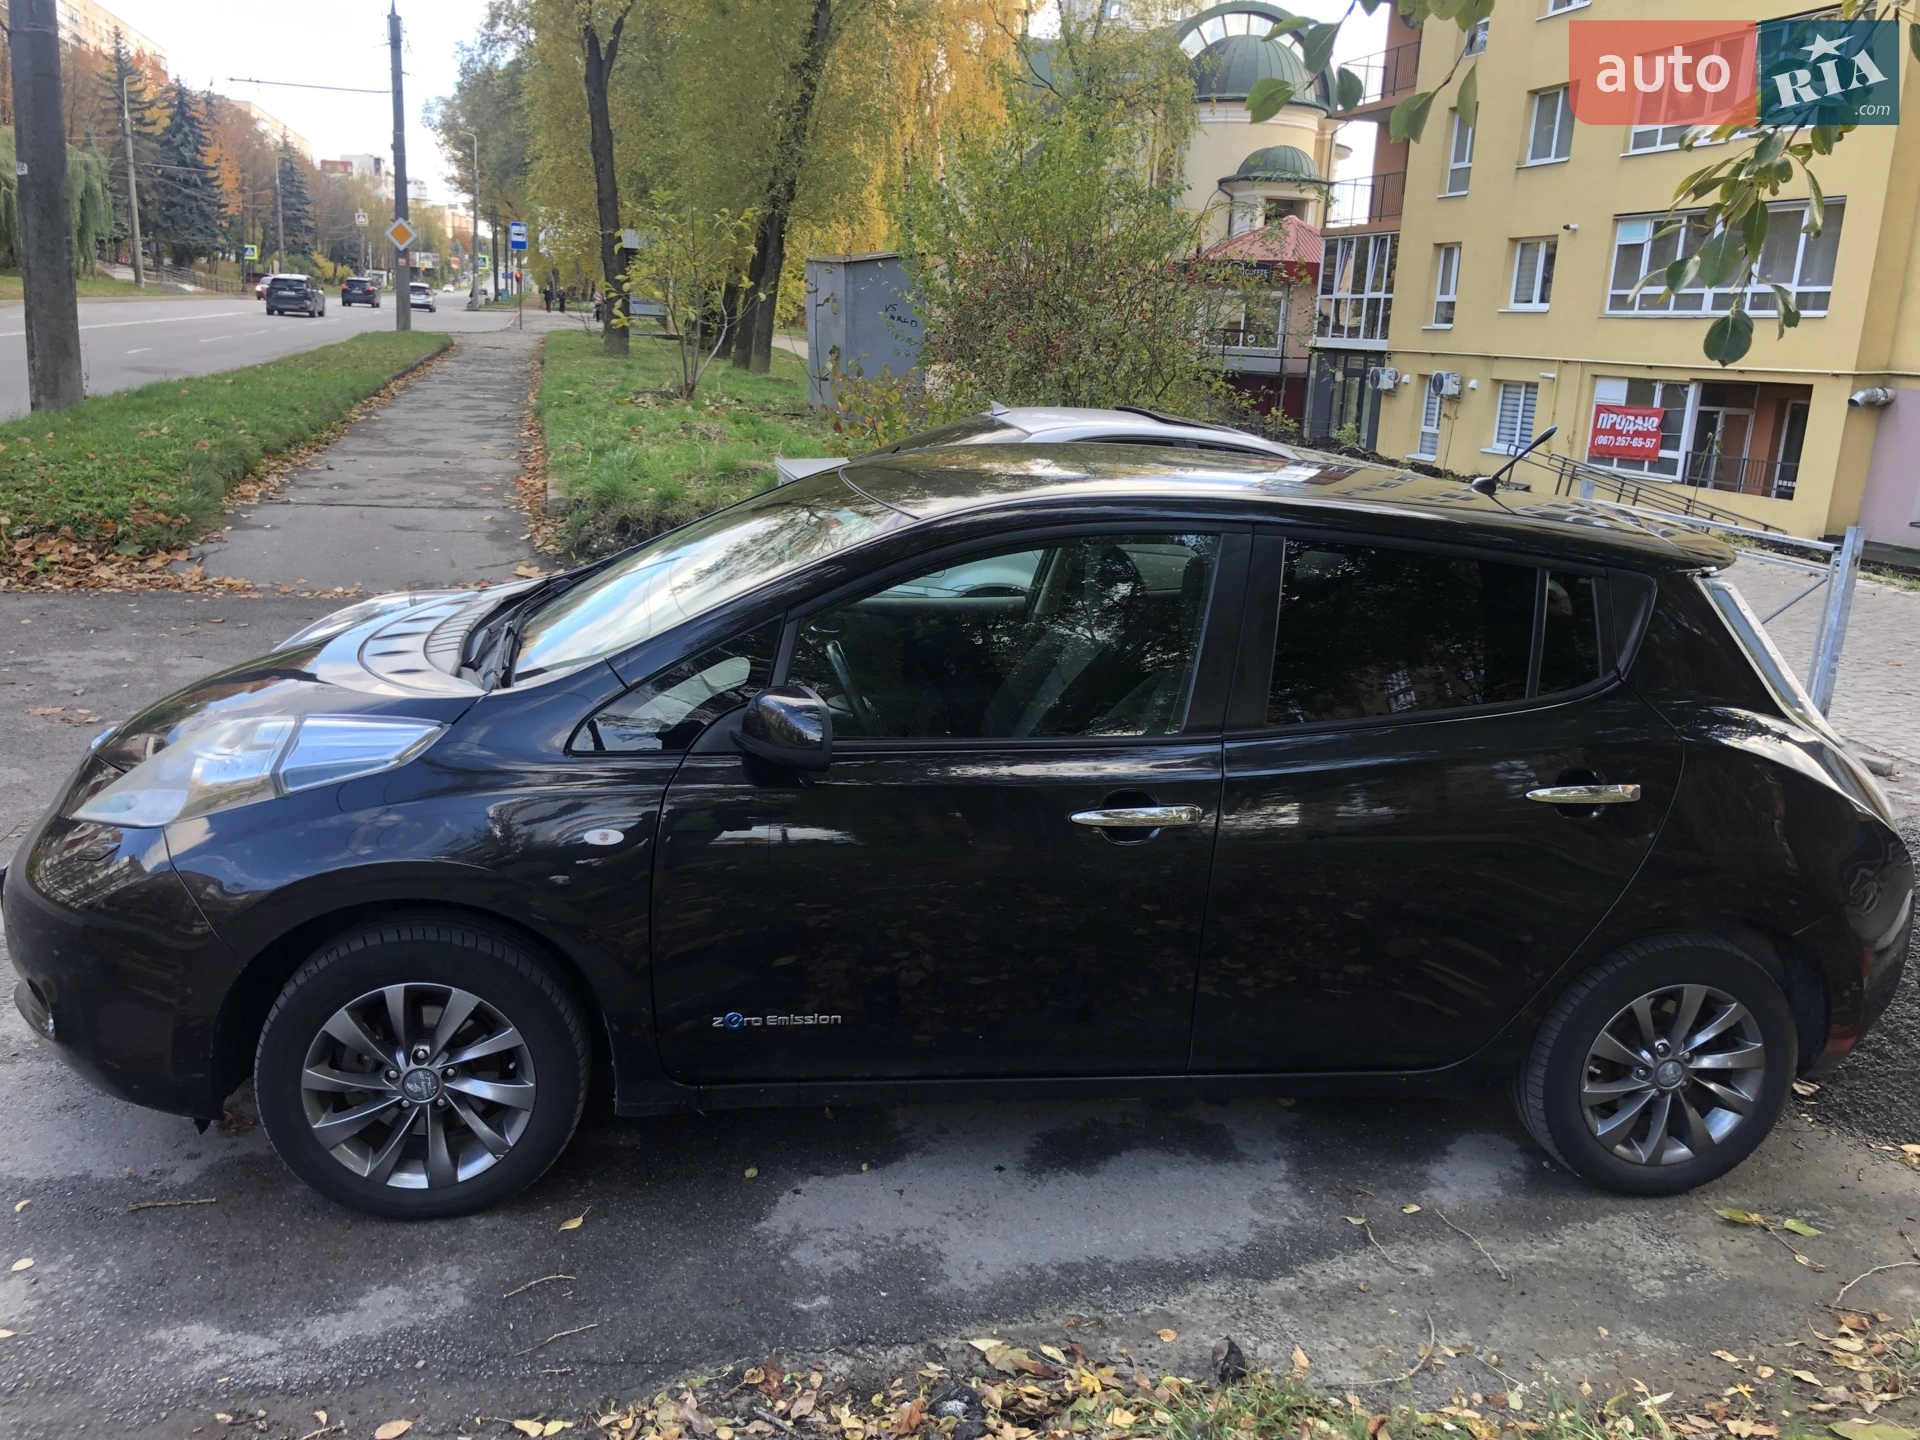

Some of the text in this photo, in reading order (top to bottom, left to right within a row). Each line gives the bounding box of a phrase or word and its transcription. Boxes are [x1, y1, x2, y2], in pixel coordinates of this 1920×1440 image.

[1597, 413, 1659, 434] ПРОДАЮ
[1595, 435, 1656, 448] (067) 257-65-57
[766, 1014, 842, 1026] Emission
